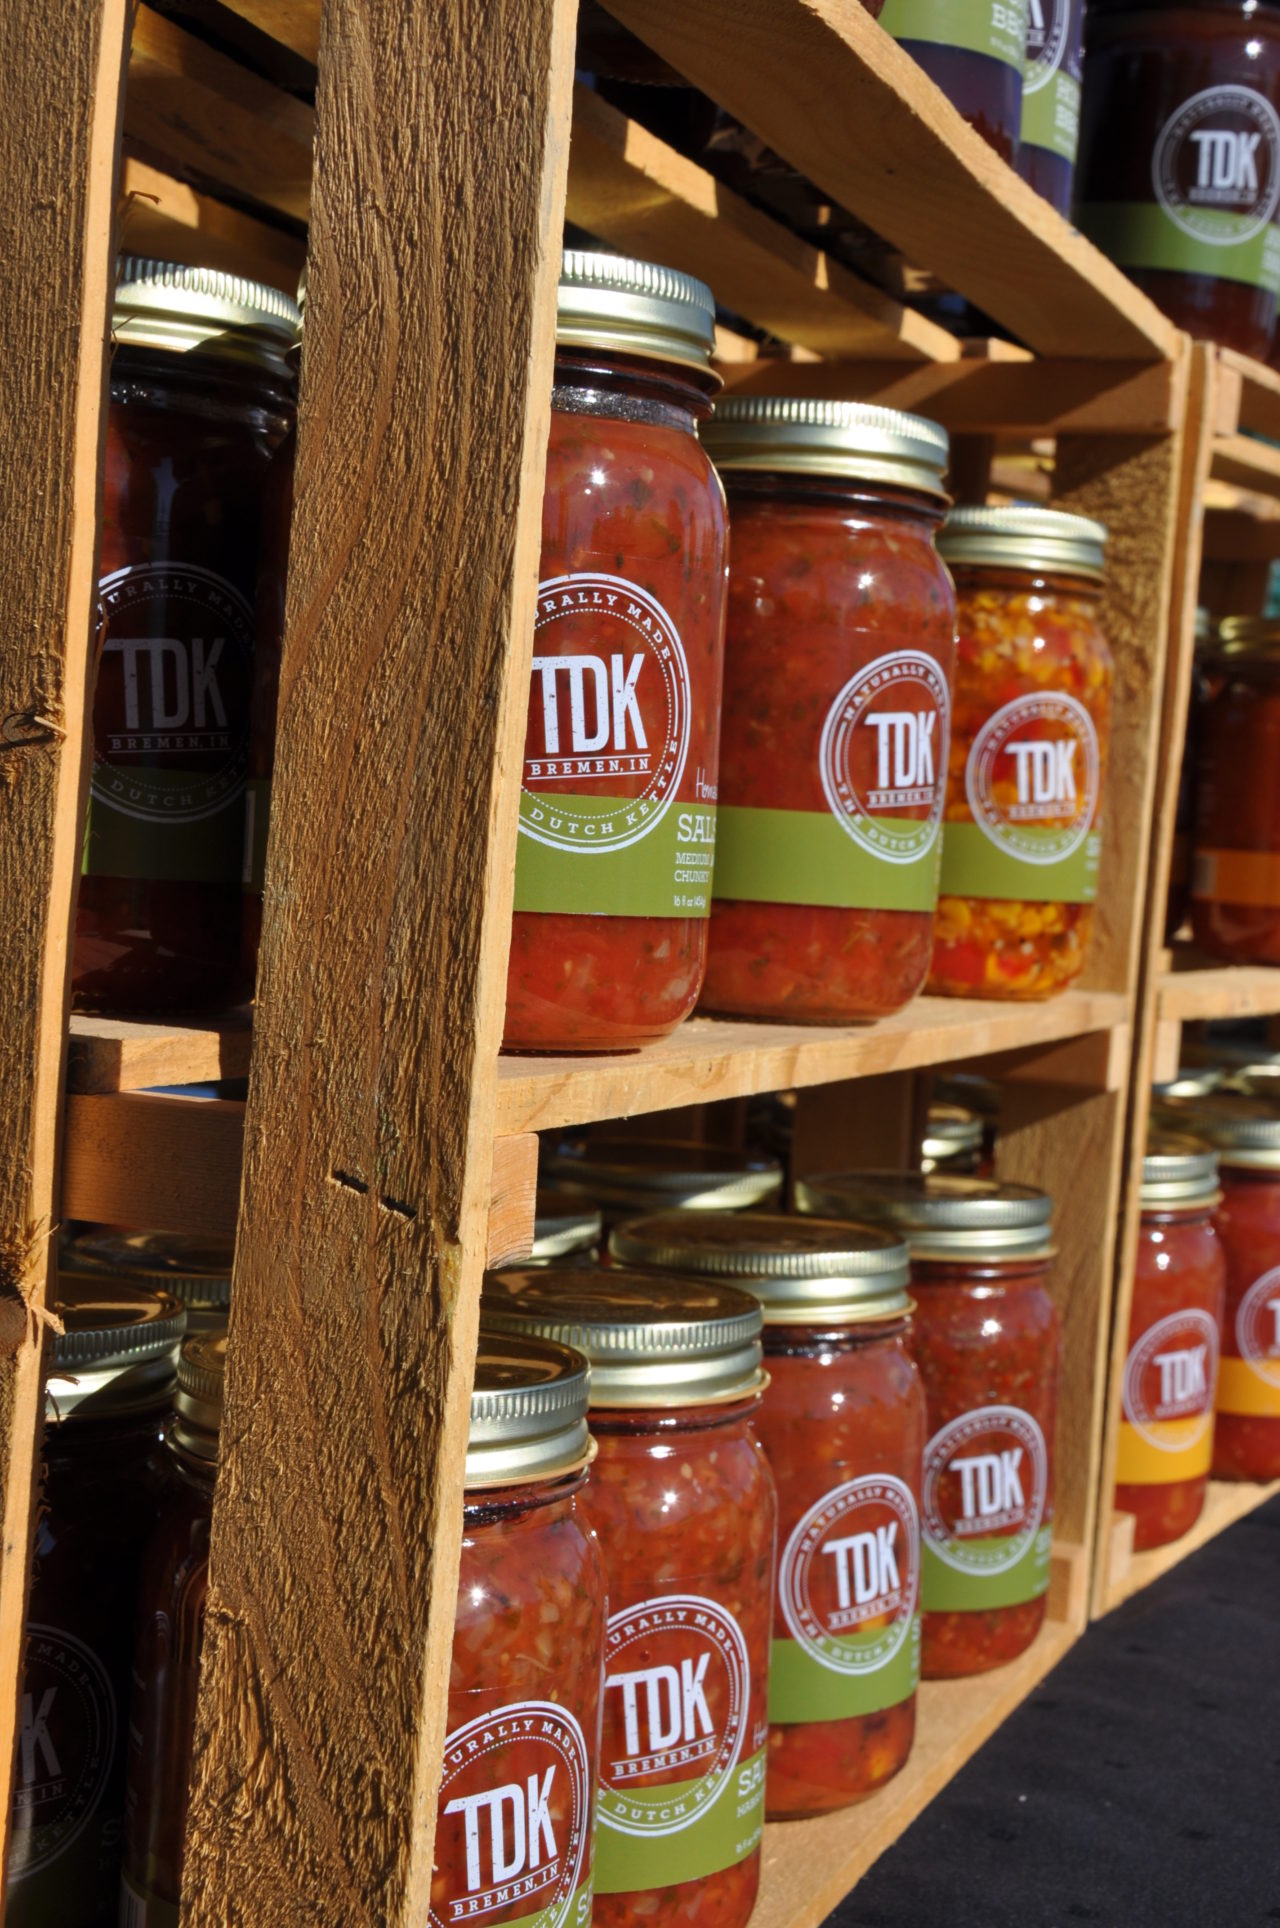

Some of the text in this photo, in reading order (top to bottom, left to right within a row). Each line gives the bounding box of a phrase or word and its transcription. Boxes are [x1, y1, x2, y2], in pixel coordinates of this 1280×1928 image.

[1189, 130, 1262, 189] TDK
[626, 602, 673, 661] MADE
[103, 638, 230, 730] TDK
[532, 653, 649, 754] TDK
[210, 735, 230, 748] IN
[530, 757, 649, 777] BREMEN, IN
[864, 711, 937, 788] TDK
[1005, 739, 1077, 804] TDK
[530, 739, 679, 837] DUTCH KETTLE
[674, 870, 710, 883] CHUNKY
[1153, 1343, 1208, 1406] TDK
[949, 1447, 1025, 1519] TDK
[821, 1520, 901, 1610] TDK
[693, 1614, 733, 1652] MADE
[605, 1652, 715, 1756] TDK
[541, 1720, 577, 1761] MADE
[614, 1739, 715, 1776] BREMEN, IN
[614, 1802, 687, 1821] DUTCH
[694, 1714, 739, 1802] KETTLE
[443, 1764, 558, 1892] TDK
[453, 1862, 558, 1918] BREMEN, IN
